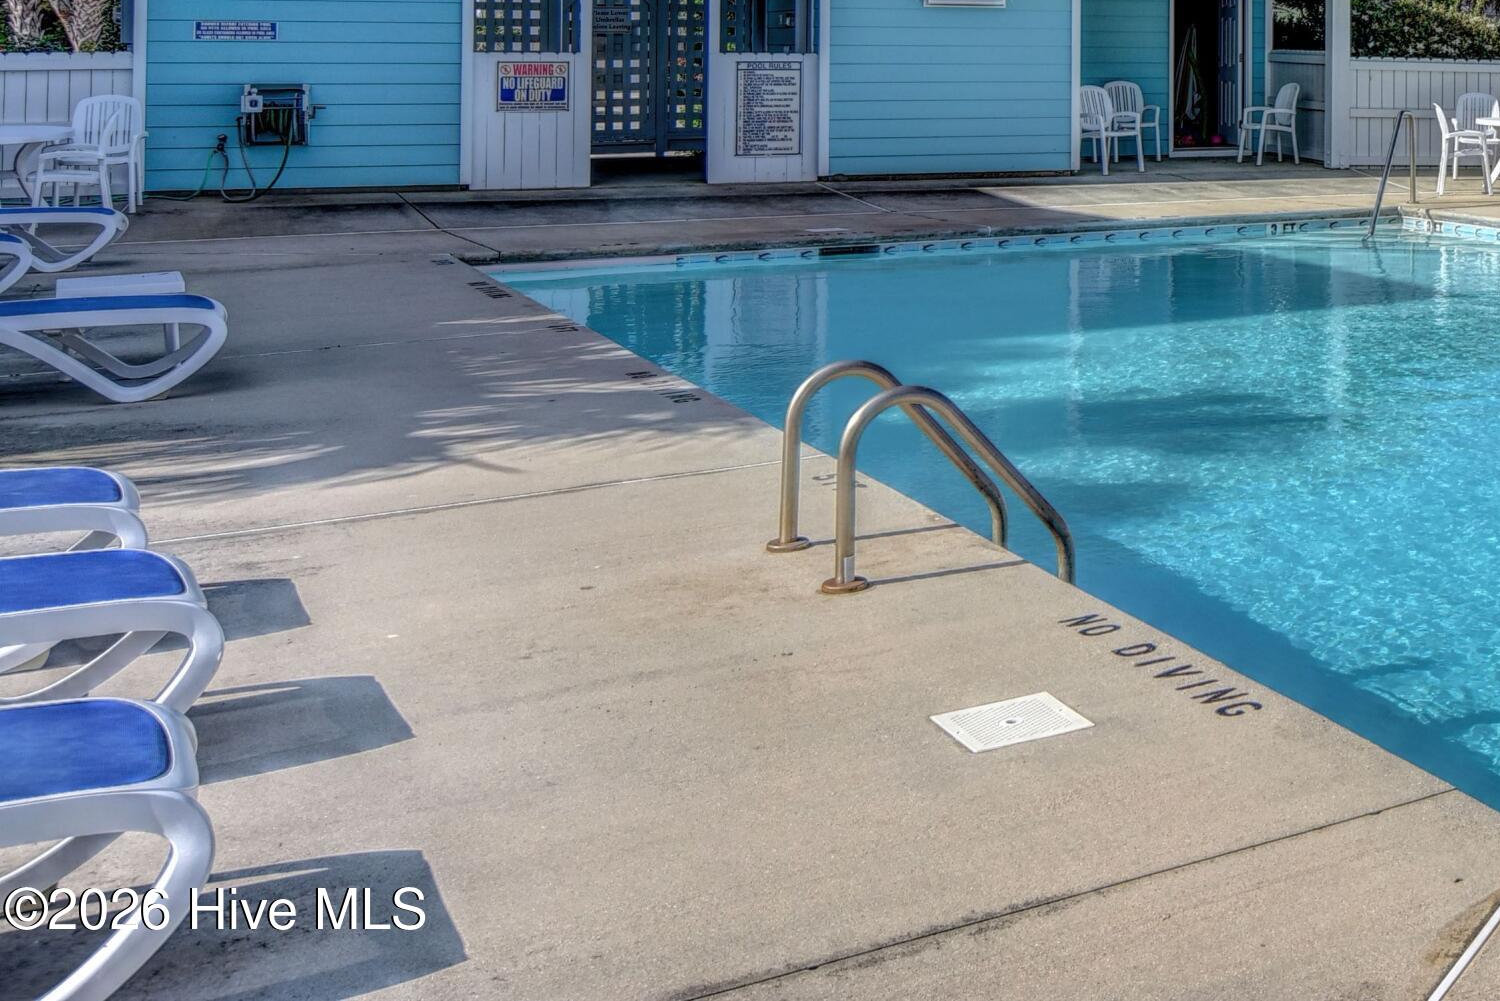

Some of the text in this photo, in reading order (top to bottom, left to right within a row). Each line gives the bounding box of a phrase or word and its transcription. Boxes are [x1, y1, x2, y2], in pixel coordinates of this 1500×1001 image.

[513, 64, 554, 76] WARNING
[502, 77, 563, 89] NO LIFEGUARD
[515, 90, 553, 102] ON DUTY
[1057, 614, 1262, 717] NO DIVING
